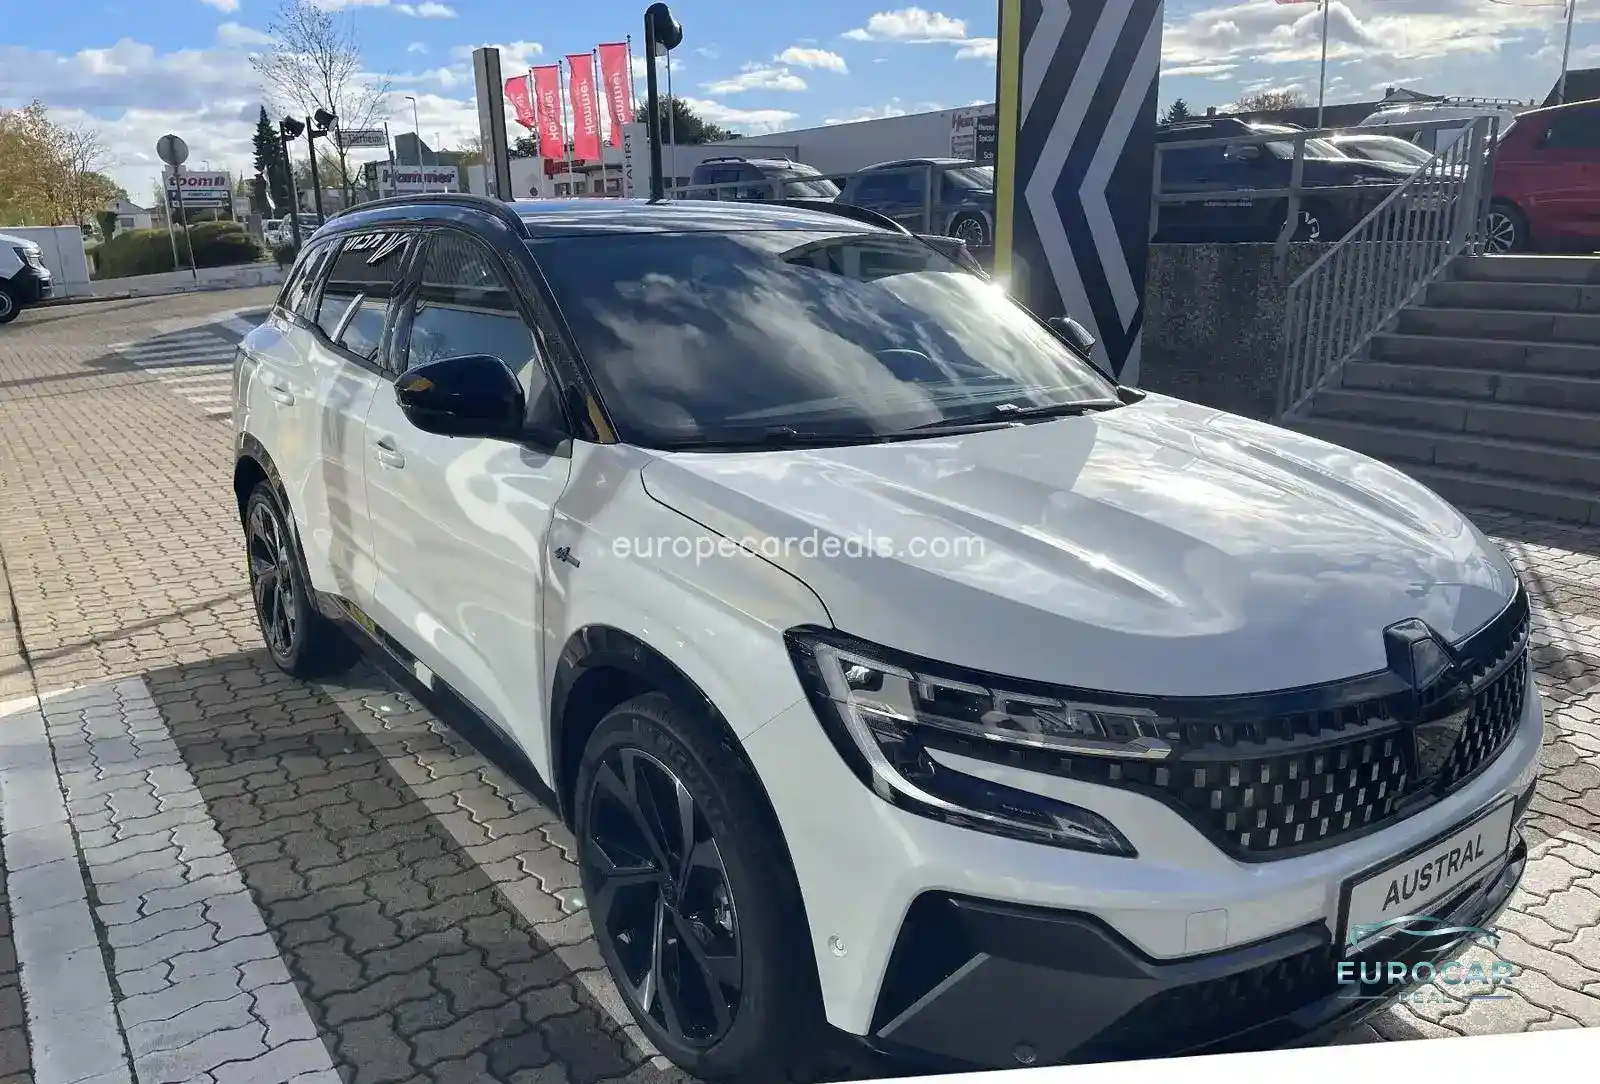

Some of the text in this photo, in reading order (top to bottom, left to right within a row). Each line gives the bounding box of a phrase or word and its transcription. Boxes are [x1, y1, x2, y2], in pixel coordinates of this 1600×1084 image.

[580, 79, 596, 136] Hammer
[382, 169, 455, 187] Hammer
[1382, 834, 1484, 911] AUSTRAL
